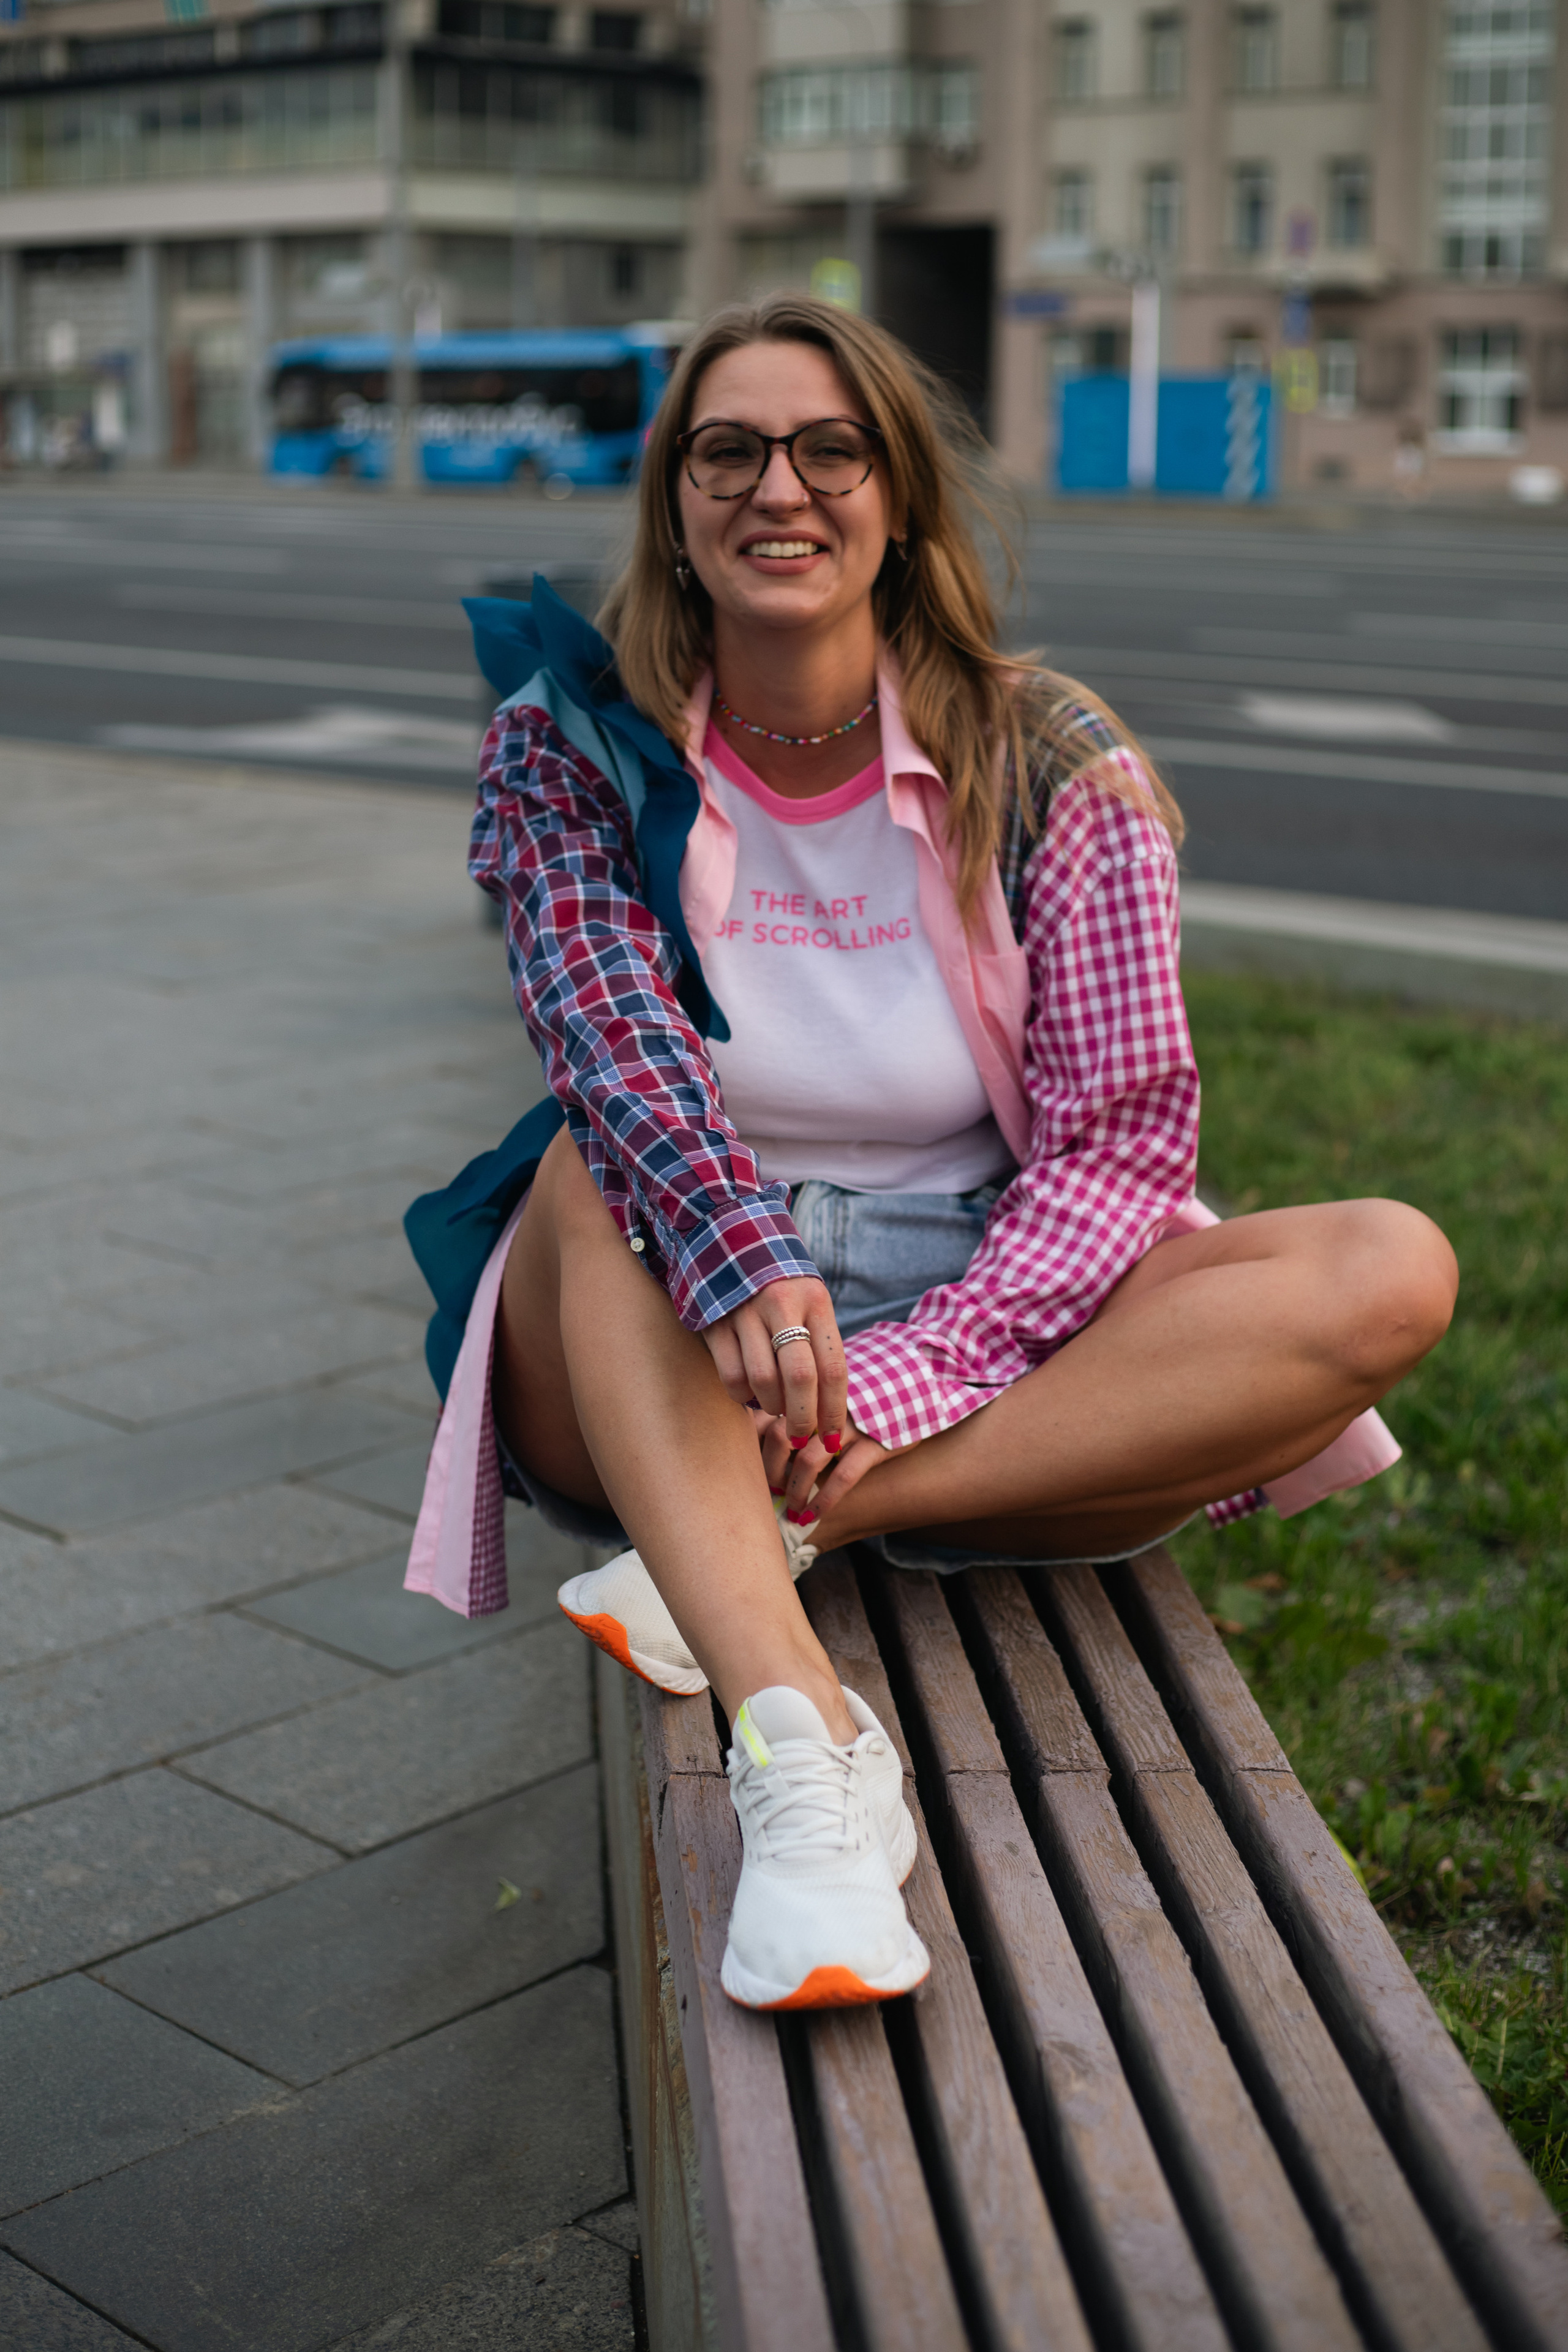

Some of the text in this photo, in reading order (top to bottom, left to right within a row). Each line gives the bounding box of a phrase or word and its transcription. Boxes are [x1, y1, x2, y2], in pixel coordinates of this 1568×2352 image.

[750, 890, 868, 921] THE ART
[752, 917, 911, 951] SCROLLING
